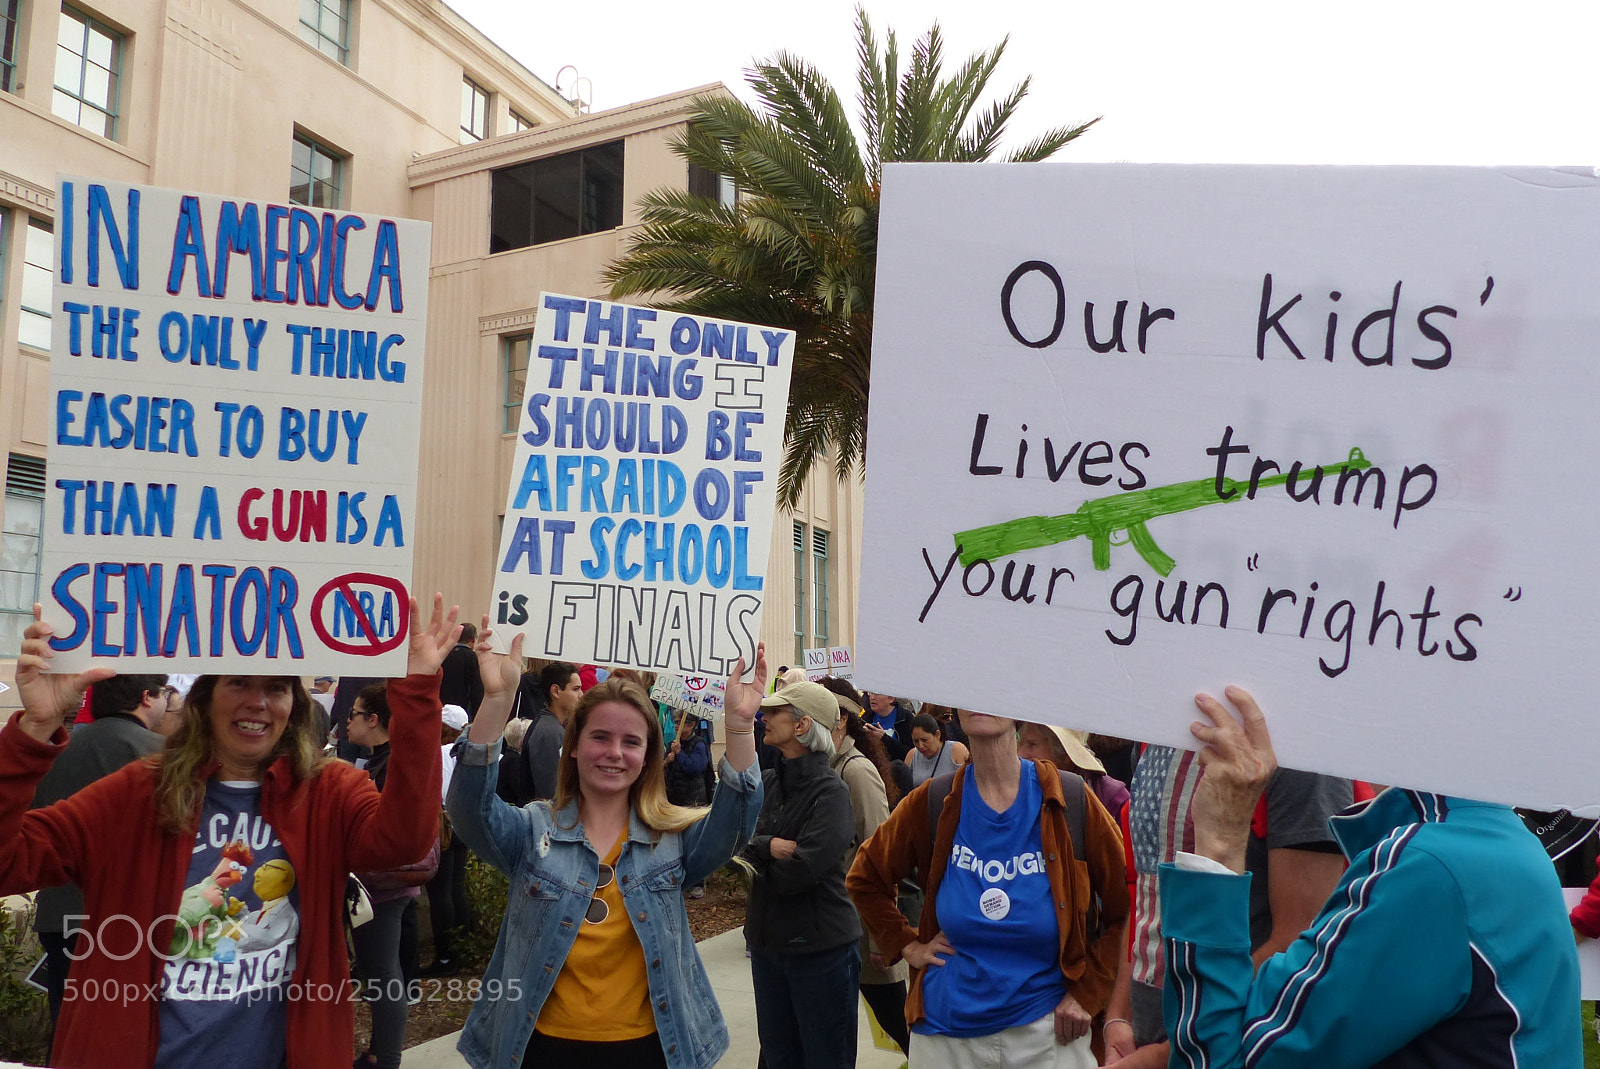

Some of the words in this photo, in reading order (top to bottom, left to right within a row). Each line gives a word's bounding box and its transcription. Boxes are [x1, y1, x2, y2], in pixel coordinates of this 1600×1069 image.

[61, 182, 140, 290] IN
[166, 195, 404, 313] AMERICA
[63, 302, 140, 362] THE
[158, 311, 267, 371] ONLY
[286, 323, 405, 384] THING
[544, 295, 658, 351] THE
[669, 316, 789, 367] ONLY
[1000, 260, 1175, 355] Our
[1256, 273, 1494, 370] kids'
[538, 345, 704, 401] THING
[715, 363, 765, 409] I
[57, 390, 198, 457] EASIER
[215, 402, 264, 459] TO
[278, 406, 368, 465] BUY
[523, 392, 688, 454] SHOULD
[705, 410, 764, 462] BE
[512, 454, 687, 518] AFRAID
[693, 468, 763, 522] OF
[968, 413, 1150, 491] Lives
[1205, 425, 1438, 528] trump
[56, 479, 177, 538] THAN
[194, 486, 222, 540] A
[237, 488, 327, 543] GUN
[336, 491, 368, 544] IS
[373, 494, 404, 547] A
[500, 517, 575, 575] AT
[580, 516, 764, 591] SCHOOL
[48, 562, 304, 659] SENATOR
[333, 590, 394, 638] NRA
[497, 591, 529, 626] is
[544, 581, 761, 676] FINALS
[918, 544, 1075, 623] your
[1104, 574, 1230, 646] gun
[658, 675, 683, 694] OUR
[809, 651, 825, 665] NO
[832, 649, 851, 664] NRA
[652, 688, 715, 721] GRANDKIDS
[192, 811, 282, 855] CAU
